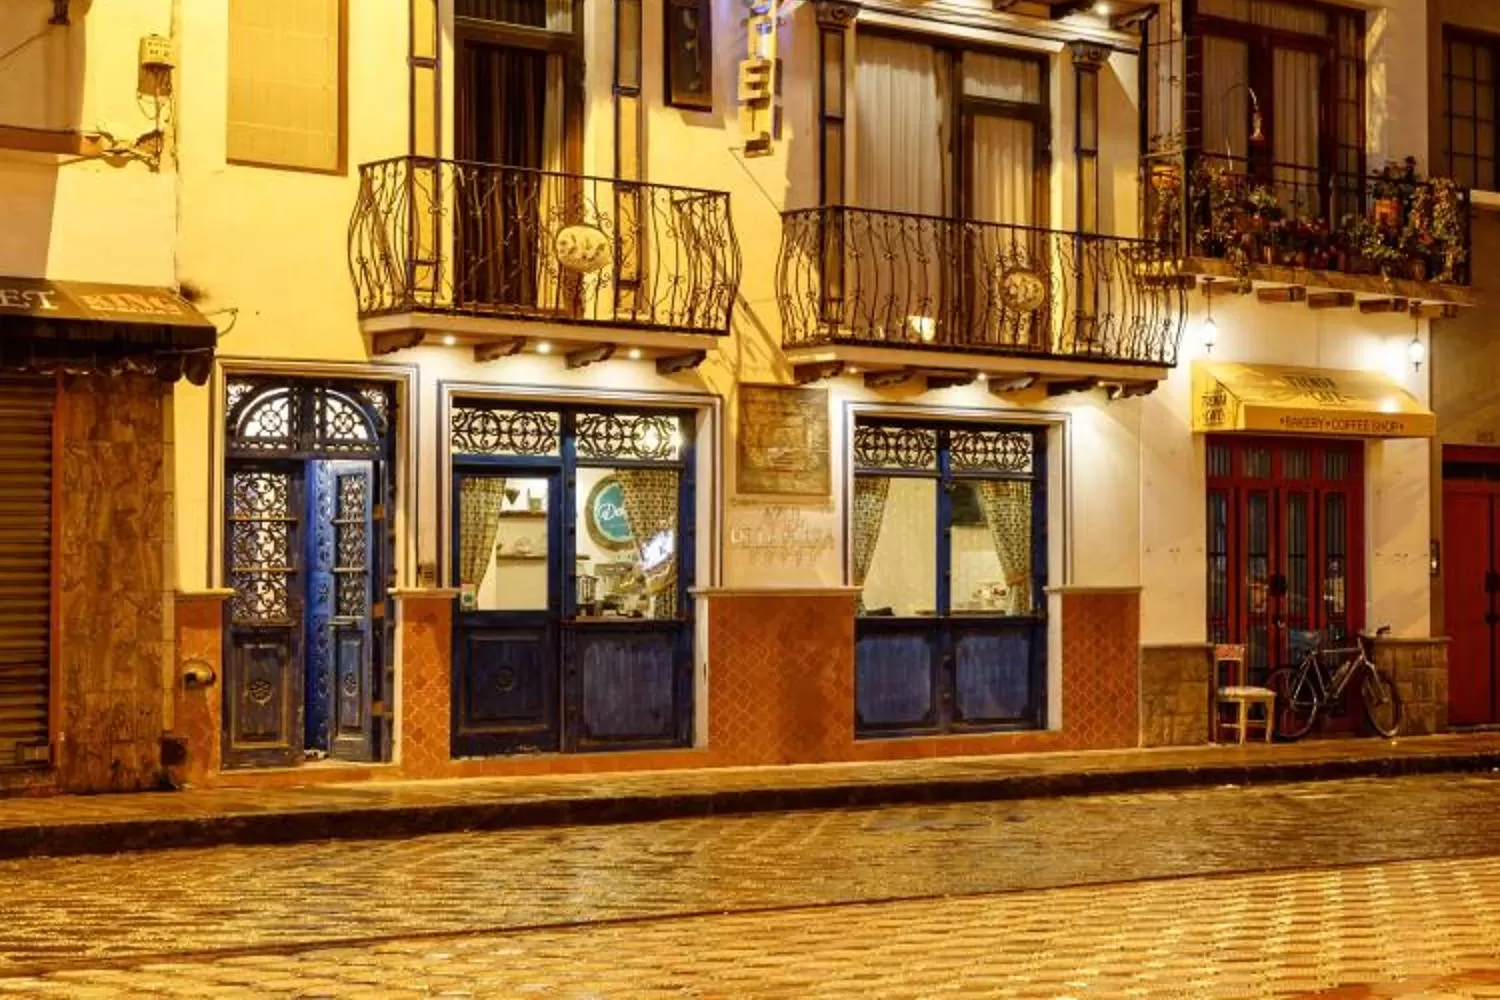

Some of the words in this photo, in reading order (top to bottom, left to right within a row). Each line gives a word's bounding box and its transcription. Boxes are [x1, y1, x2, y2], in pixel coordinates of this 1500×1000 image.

[1284, 415, 1325, 429] BAKERY
[1331, 418, 1371, 432] COFFEE
[1372, 419, 1399, 433] SHOP
